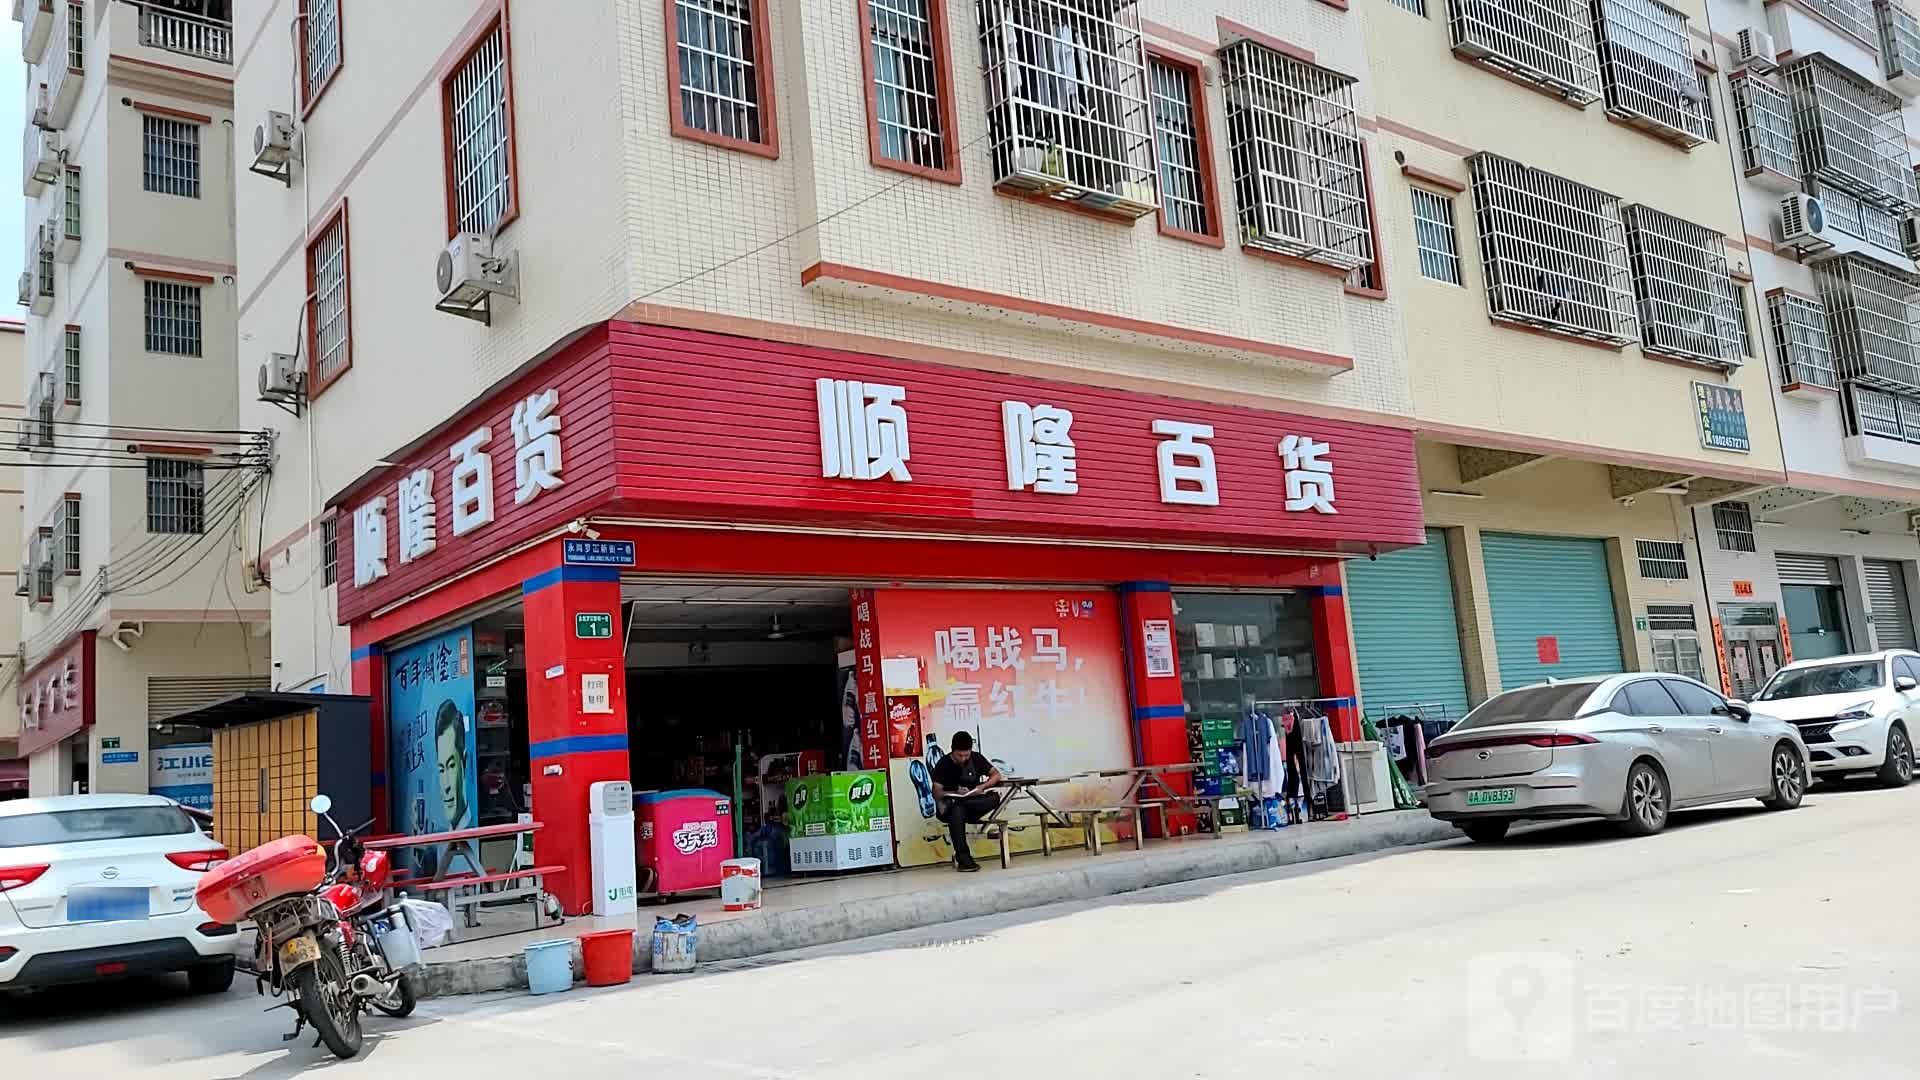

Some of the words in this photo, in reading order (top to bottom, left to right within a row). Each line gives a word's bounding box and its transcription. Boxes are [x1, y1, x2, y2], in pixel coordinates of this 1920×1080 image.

[816, 377, 1339, 515] 顺隆百货
[353, 388, 565, 589] 顺隆百货
[589, 622, 597, 636] 1
[674, 828, 717, 853] 巧乐兹
